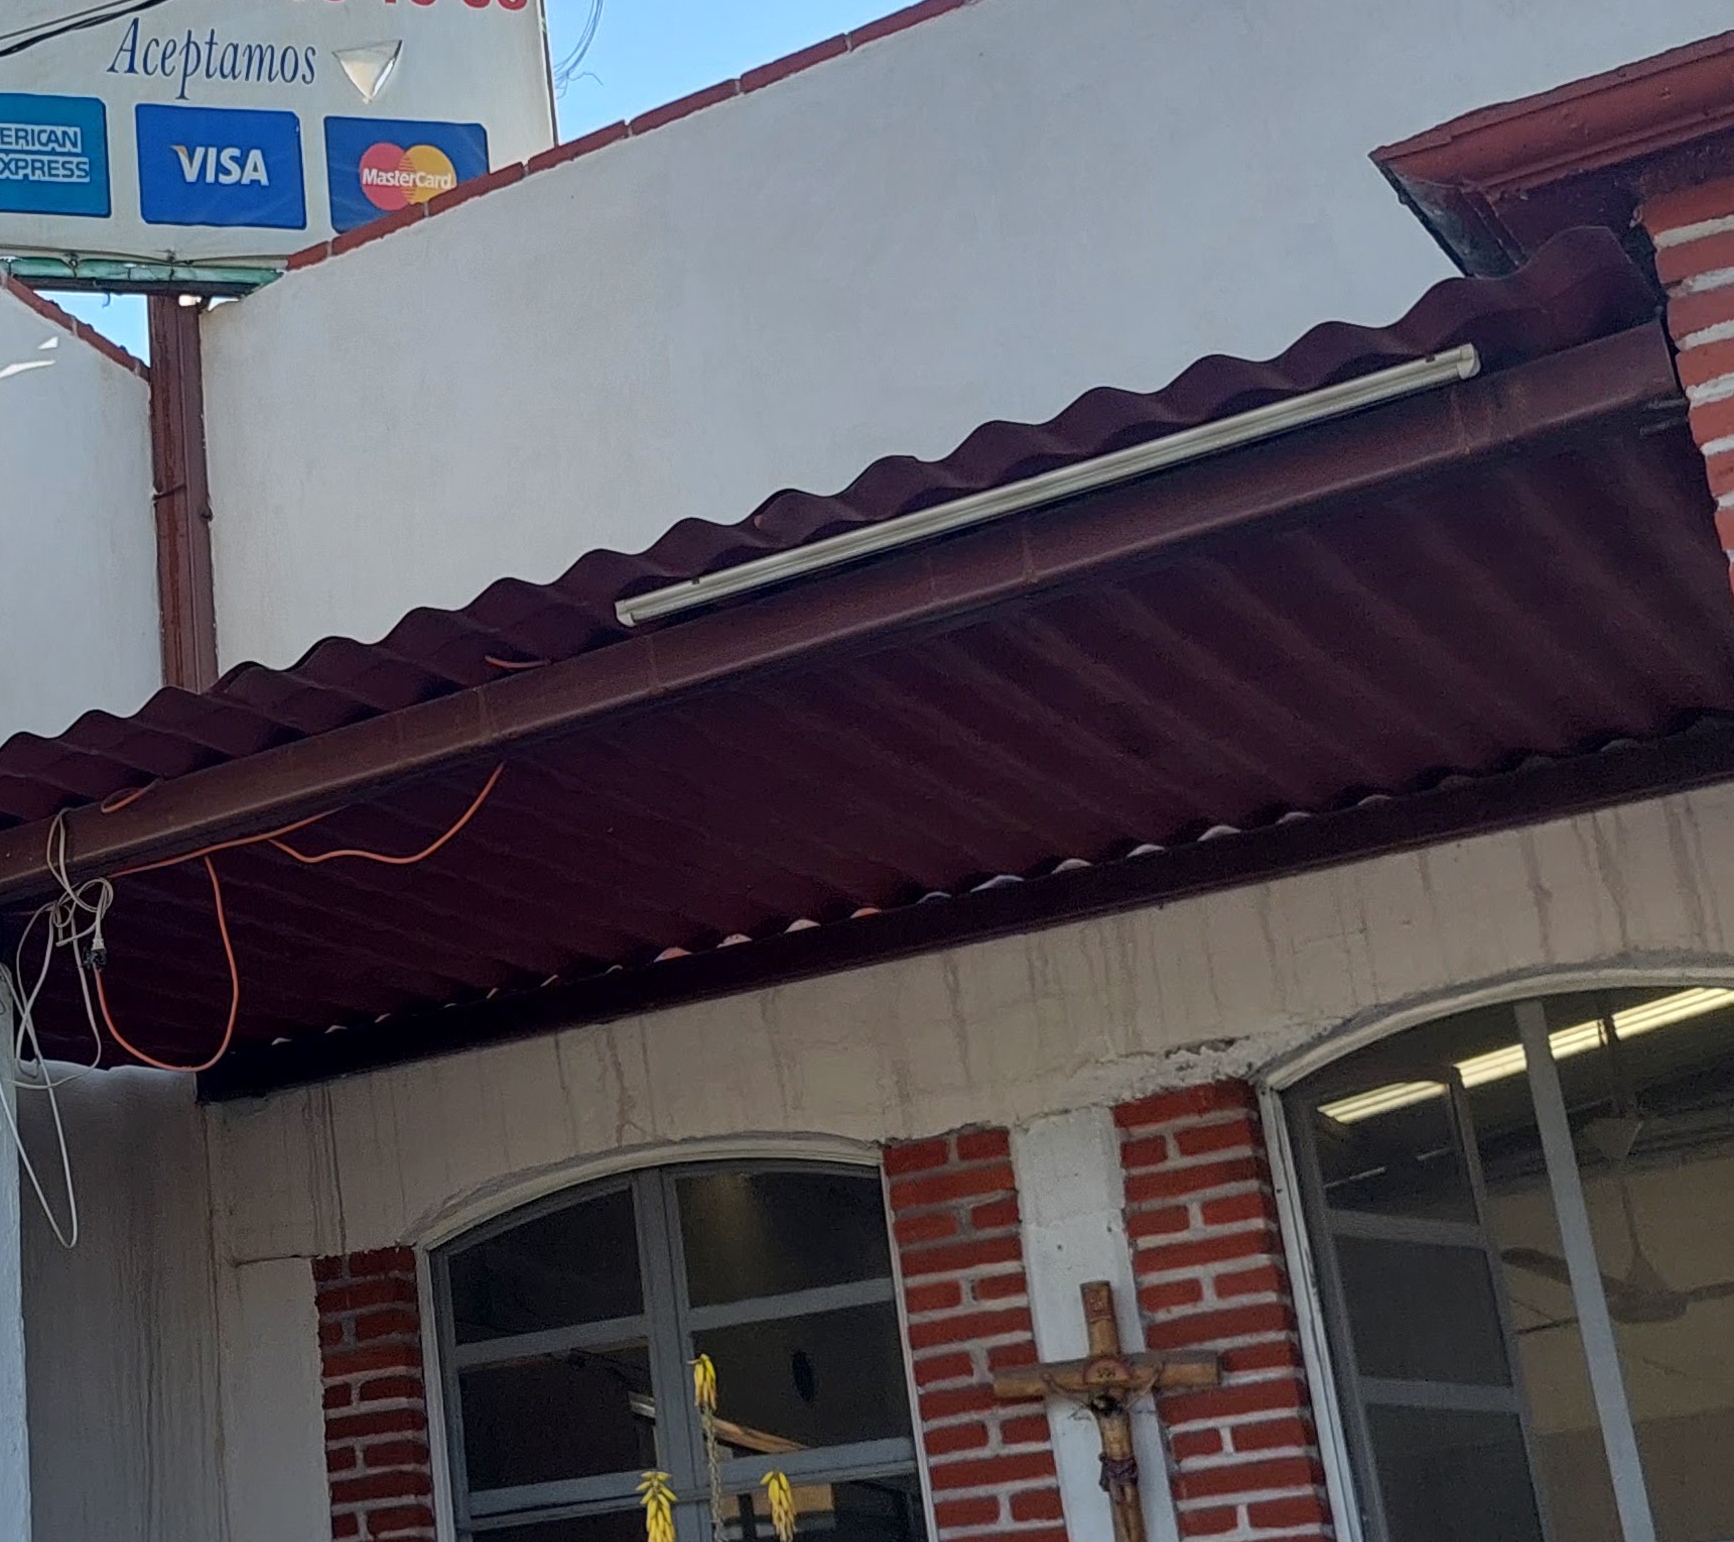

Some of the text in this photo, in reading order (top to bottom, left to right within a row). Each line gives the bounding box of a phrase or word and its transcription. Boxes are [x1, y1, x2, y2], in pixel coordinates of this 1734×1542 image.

[106, 16, 317, 101] Aceptamos
[170, 145, 270, 187] VISA
[362, 167, 454, 190] MasterCard
